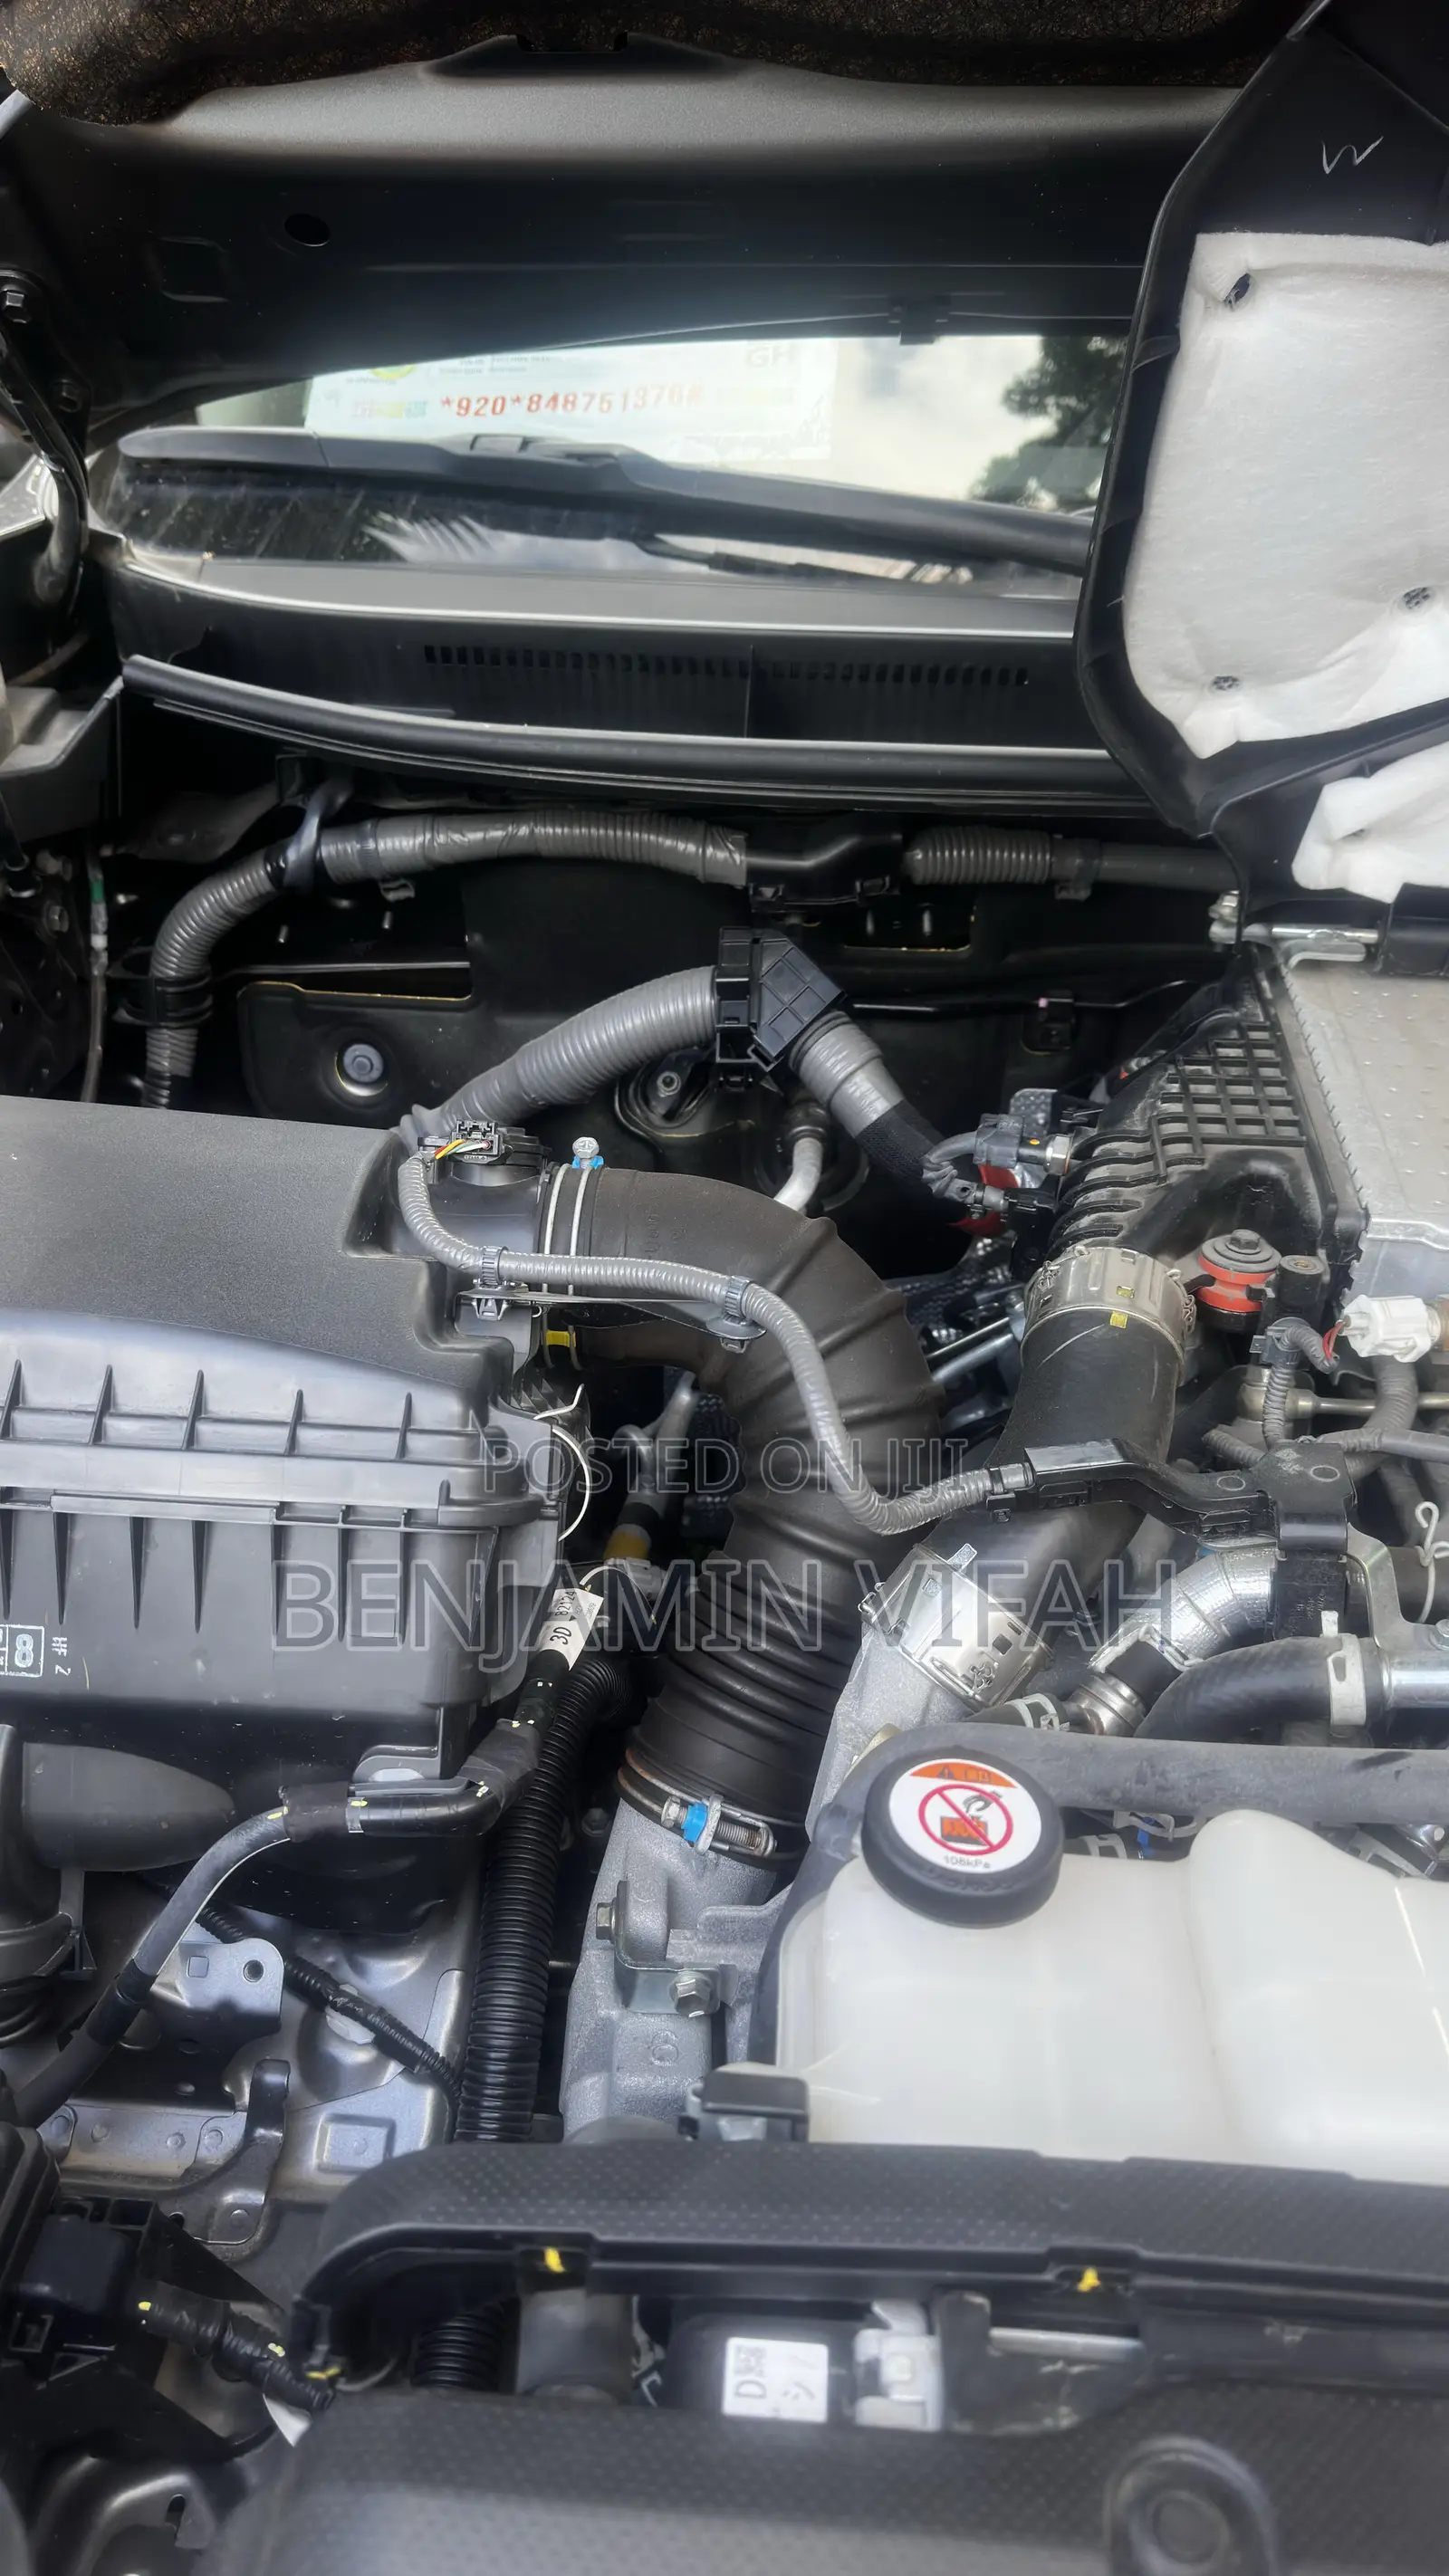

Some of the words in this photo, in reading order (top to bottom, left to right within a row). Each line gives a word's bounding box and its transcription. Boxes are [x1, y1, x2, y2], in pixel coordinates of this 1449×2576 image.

[554, 1590, 577, 1616] 82124
[549, 1626, 572, 1645] 3D
[14, 1633, 34, 1668] 8
